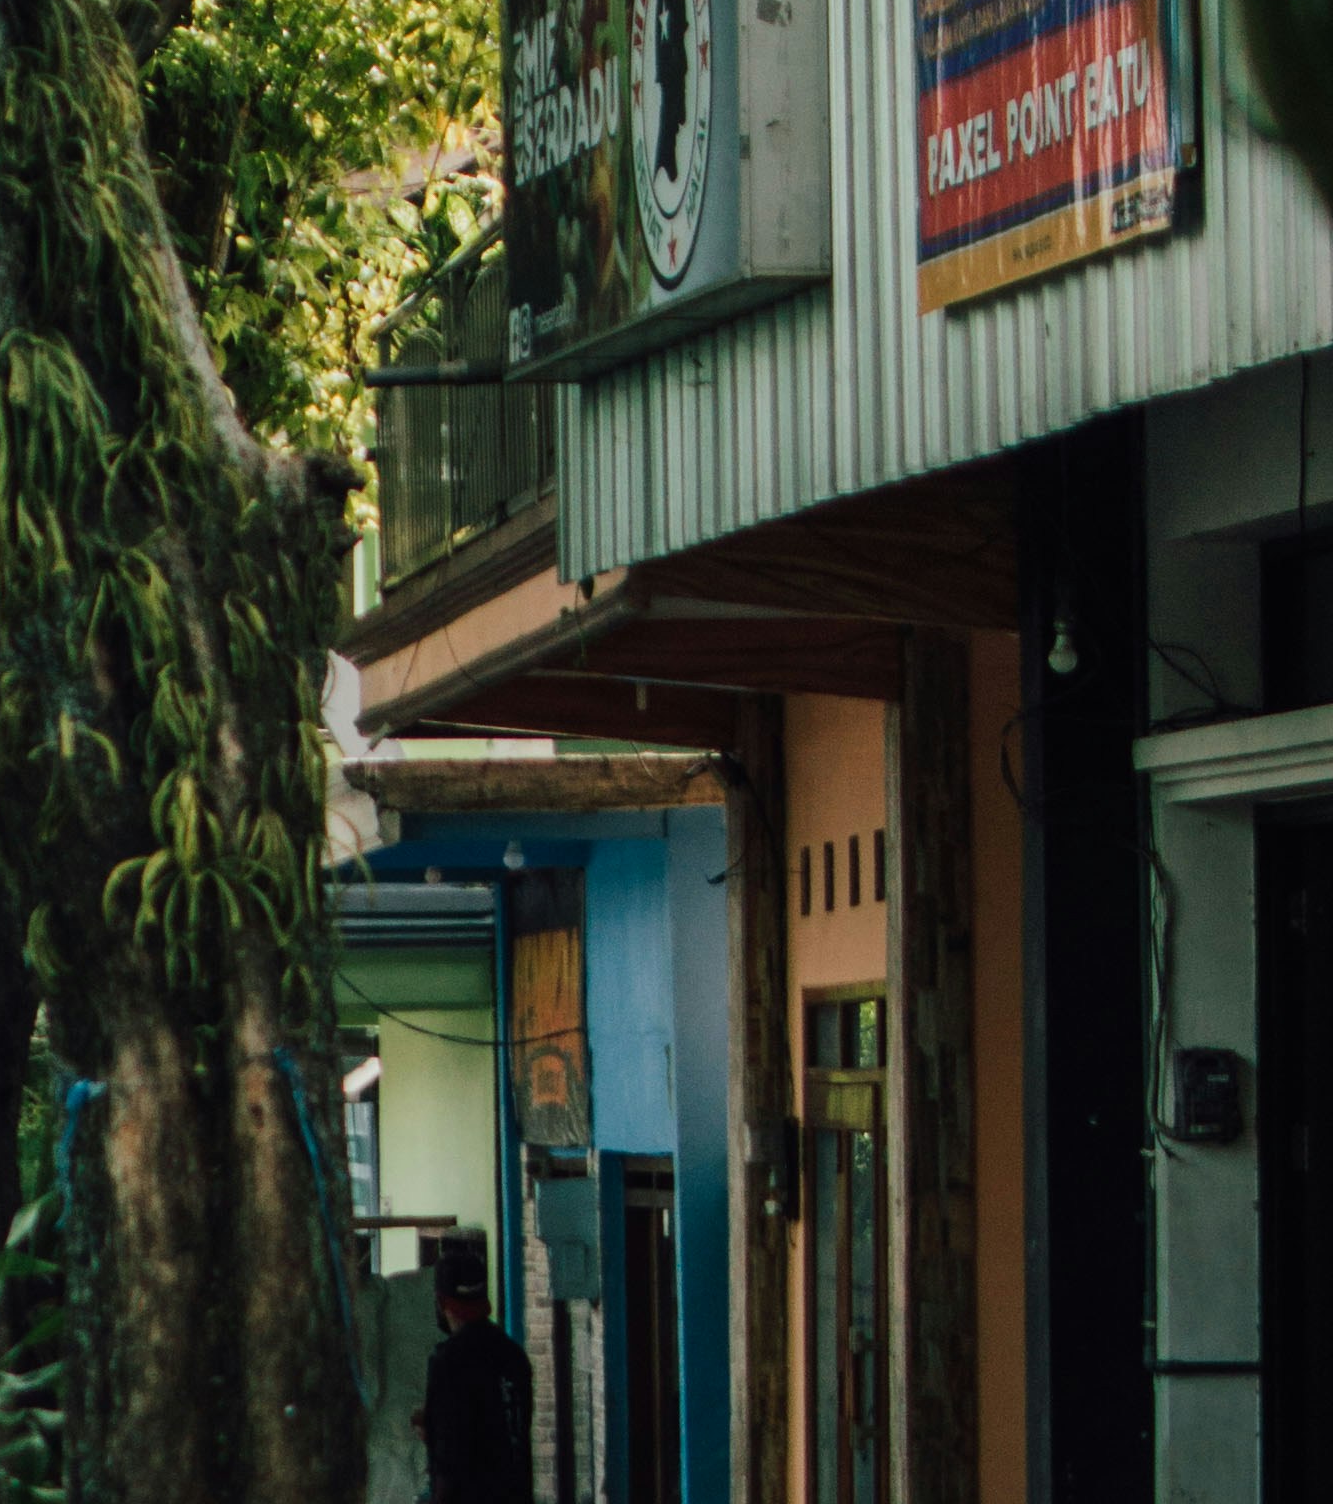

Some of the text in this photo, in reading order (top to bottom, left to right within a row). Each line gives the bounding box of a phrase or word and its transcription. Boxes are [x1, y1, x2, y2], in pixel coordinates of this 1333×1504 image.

[523, 12, 557, 103] MIE
[523, 55, 620, 185] SERDADU
[927, 38, 1150, 196] PAXEL POINT BATU
